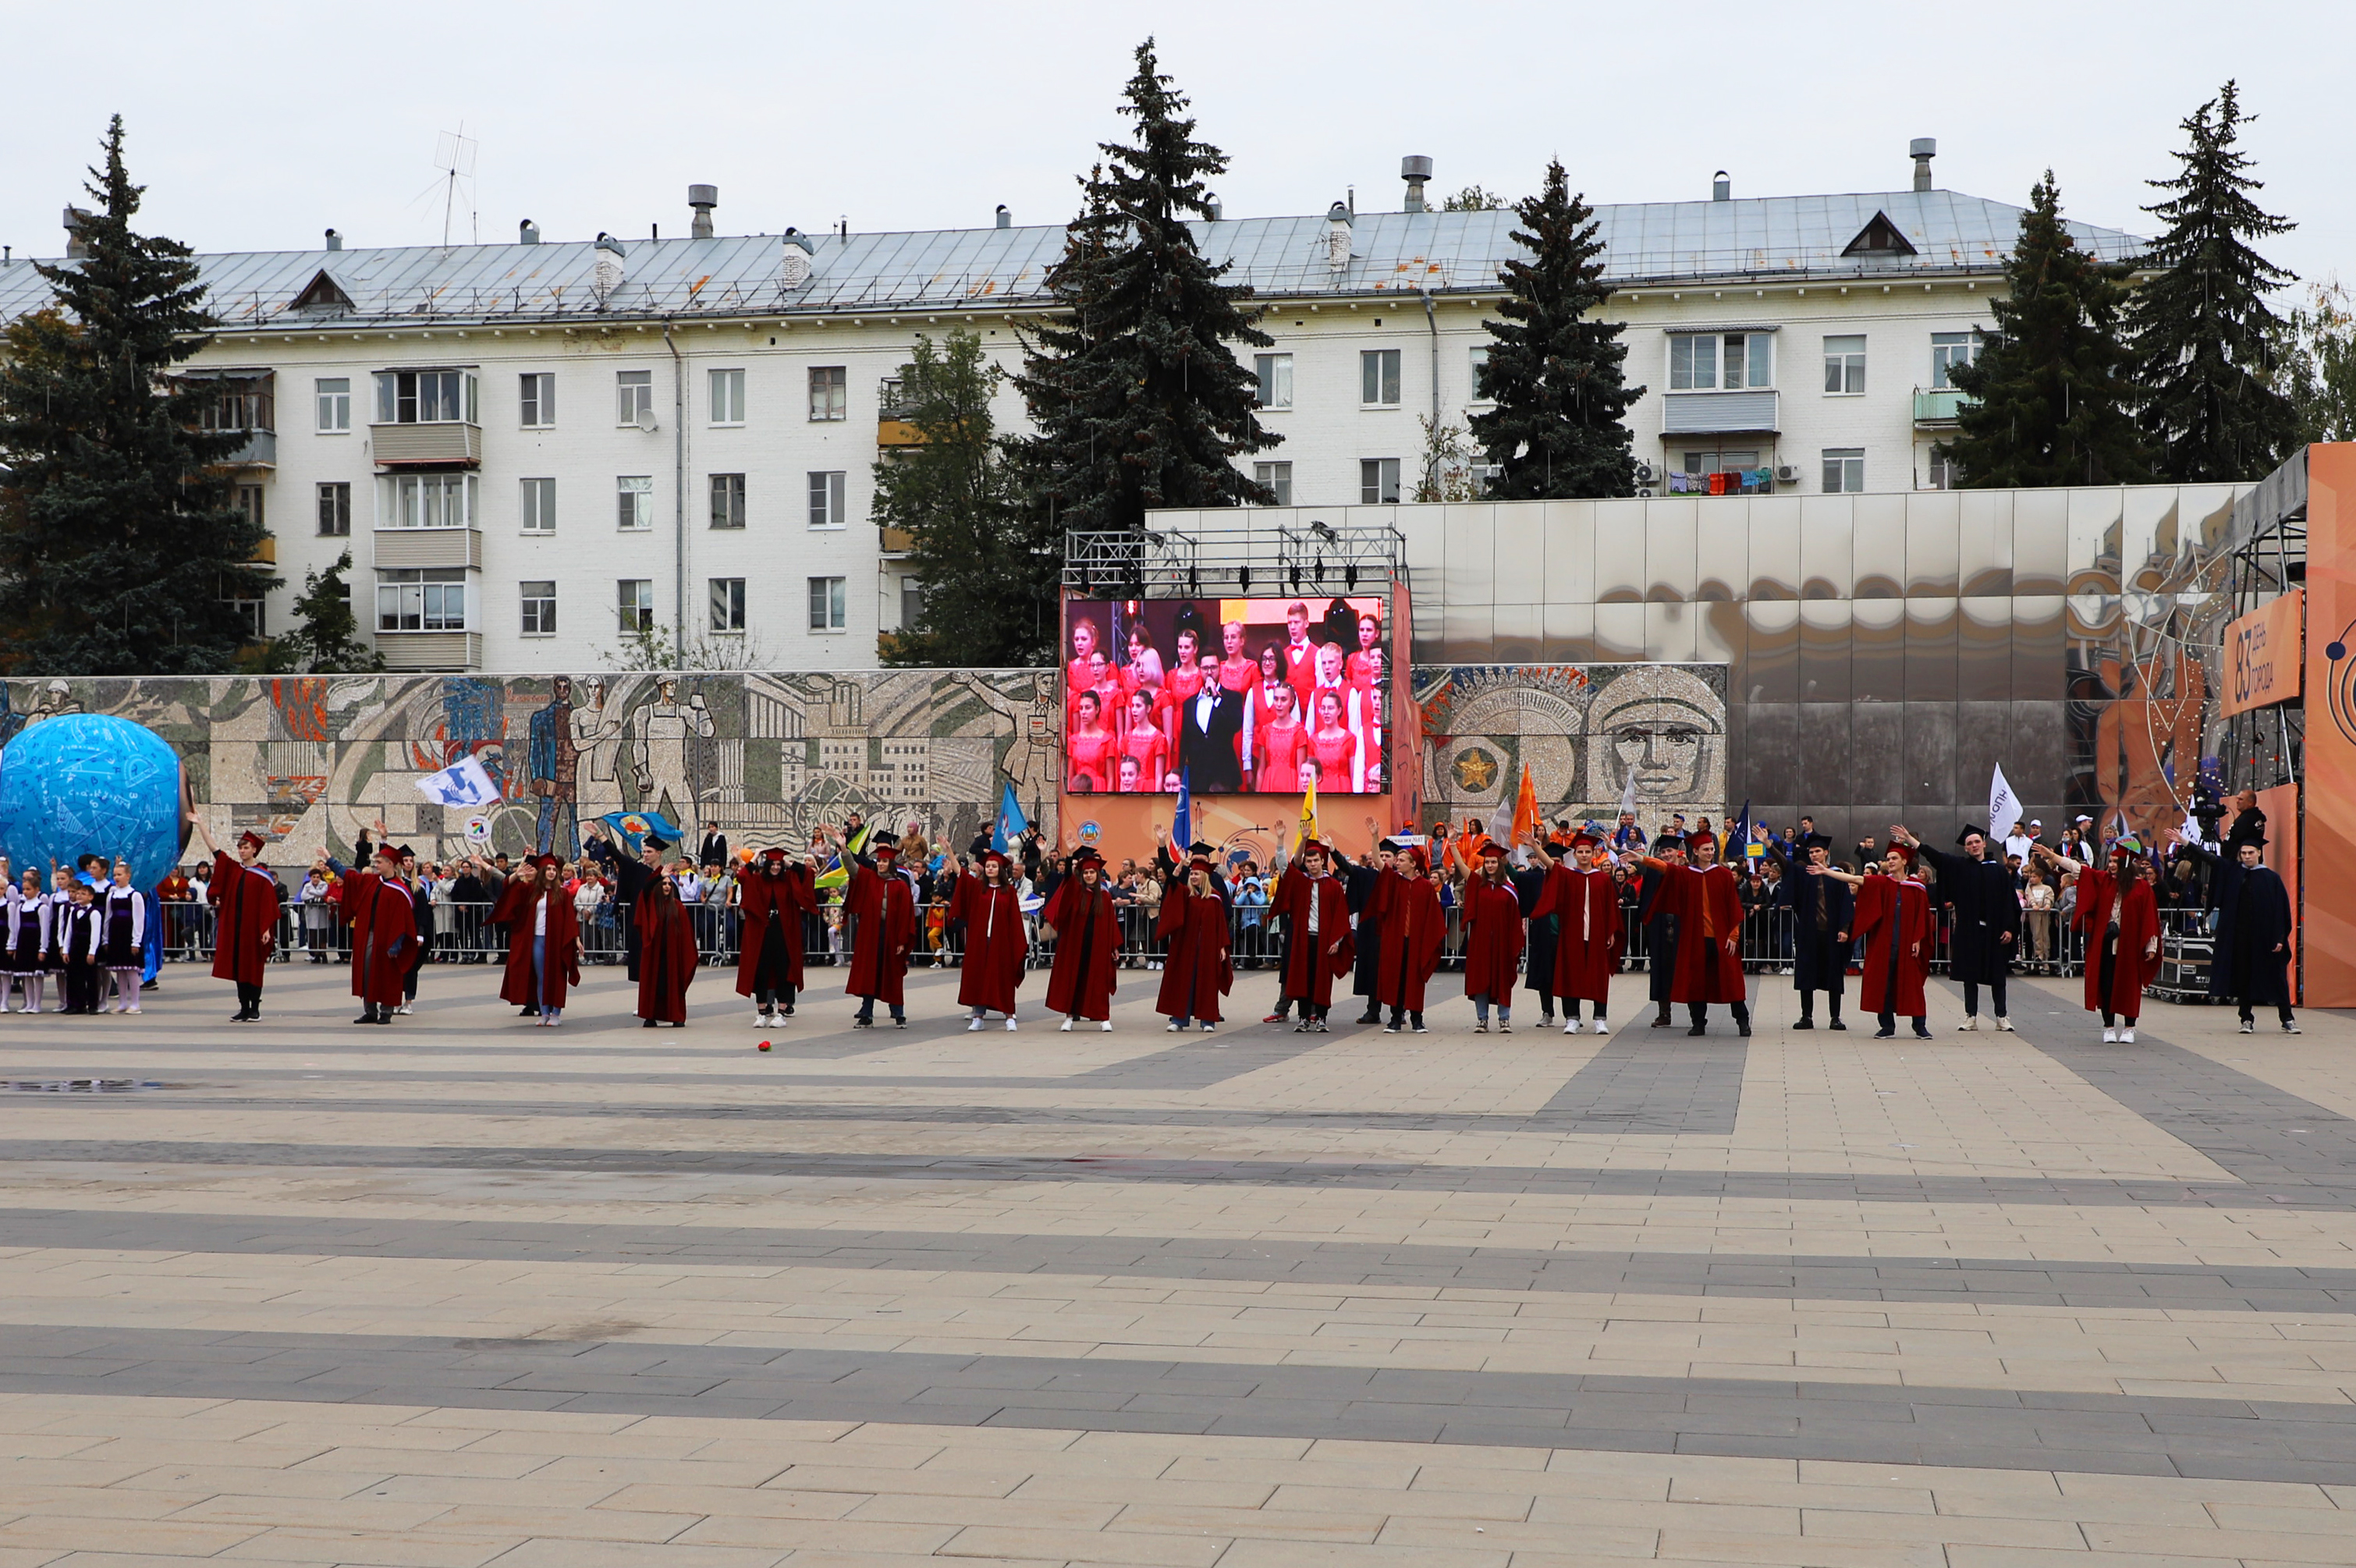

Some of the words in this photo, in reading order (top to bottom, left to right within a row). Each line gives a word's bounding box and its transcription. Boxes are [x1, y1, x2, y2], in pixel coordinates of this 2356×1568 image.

[2251, 621, 2266, 656] ДЕНЬ
[2235, 629, 2251, 704] 83
[2251, 662, 2273, 694] ГОРОДА
